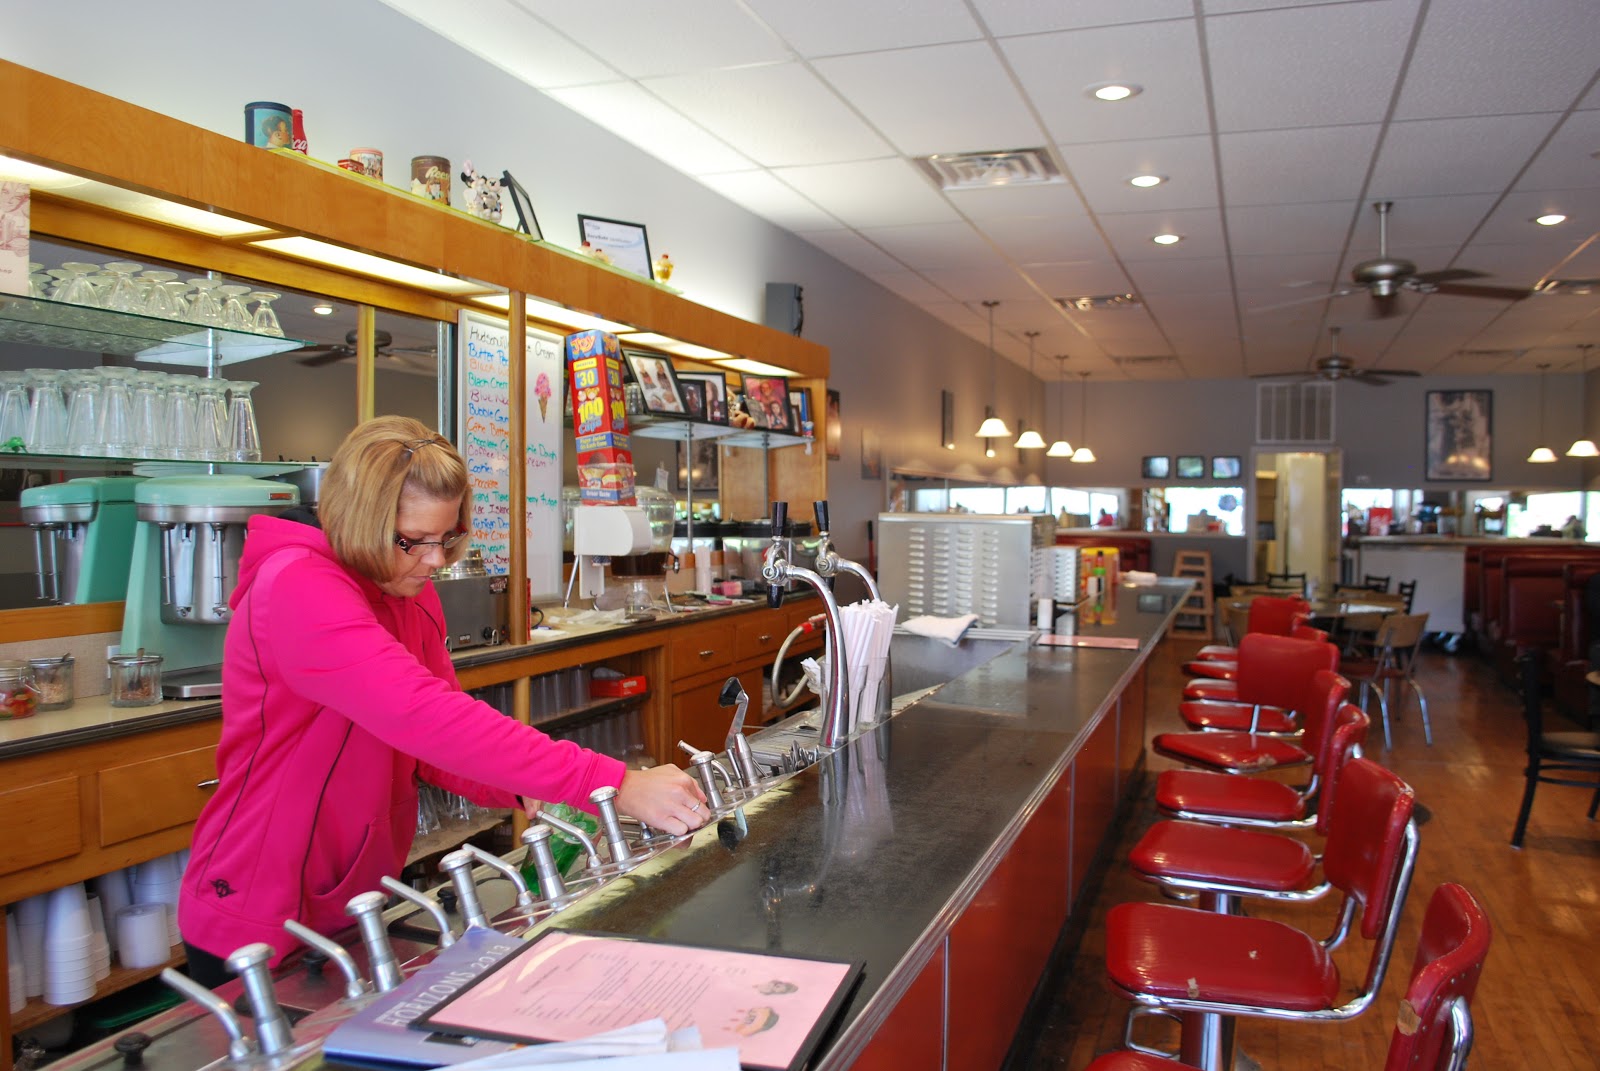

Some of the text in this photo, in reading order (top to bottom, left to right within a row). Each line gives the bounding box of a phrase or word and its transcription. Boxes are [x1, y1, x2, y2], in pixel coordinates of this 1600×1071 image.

[468, 402, 494, 418] Bubble
[468, 444, 494, 460] Coffee
[526, 457, 546, 468] ream
